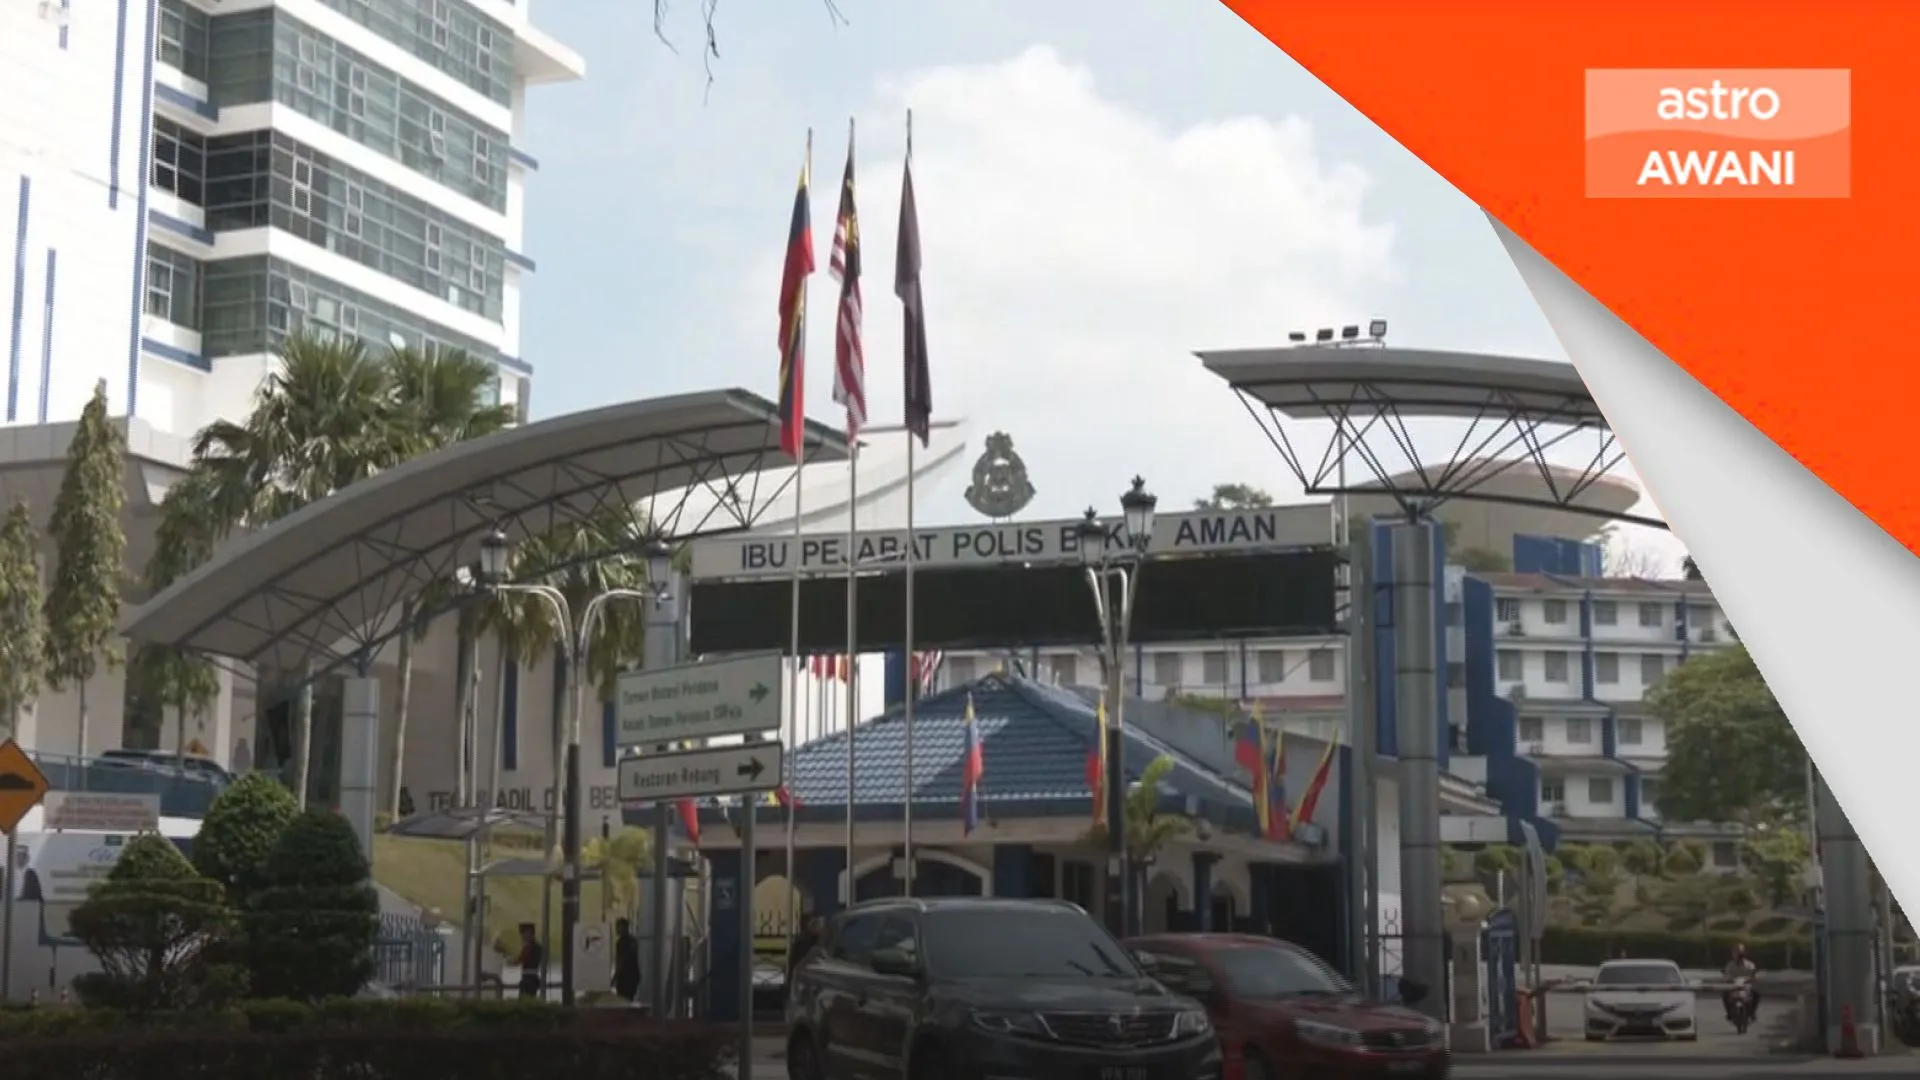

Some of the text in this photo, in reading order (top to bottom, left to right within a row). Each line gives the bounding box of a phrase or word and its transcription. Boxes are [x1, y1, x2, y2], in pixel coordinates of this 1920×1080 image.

[741, 541, 788, 570] IBU
[953, 528, 1044, 559] POLIS
[1174, 513, 1276, 547] AMAN
